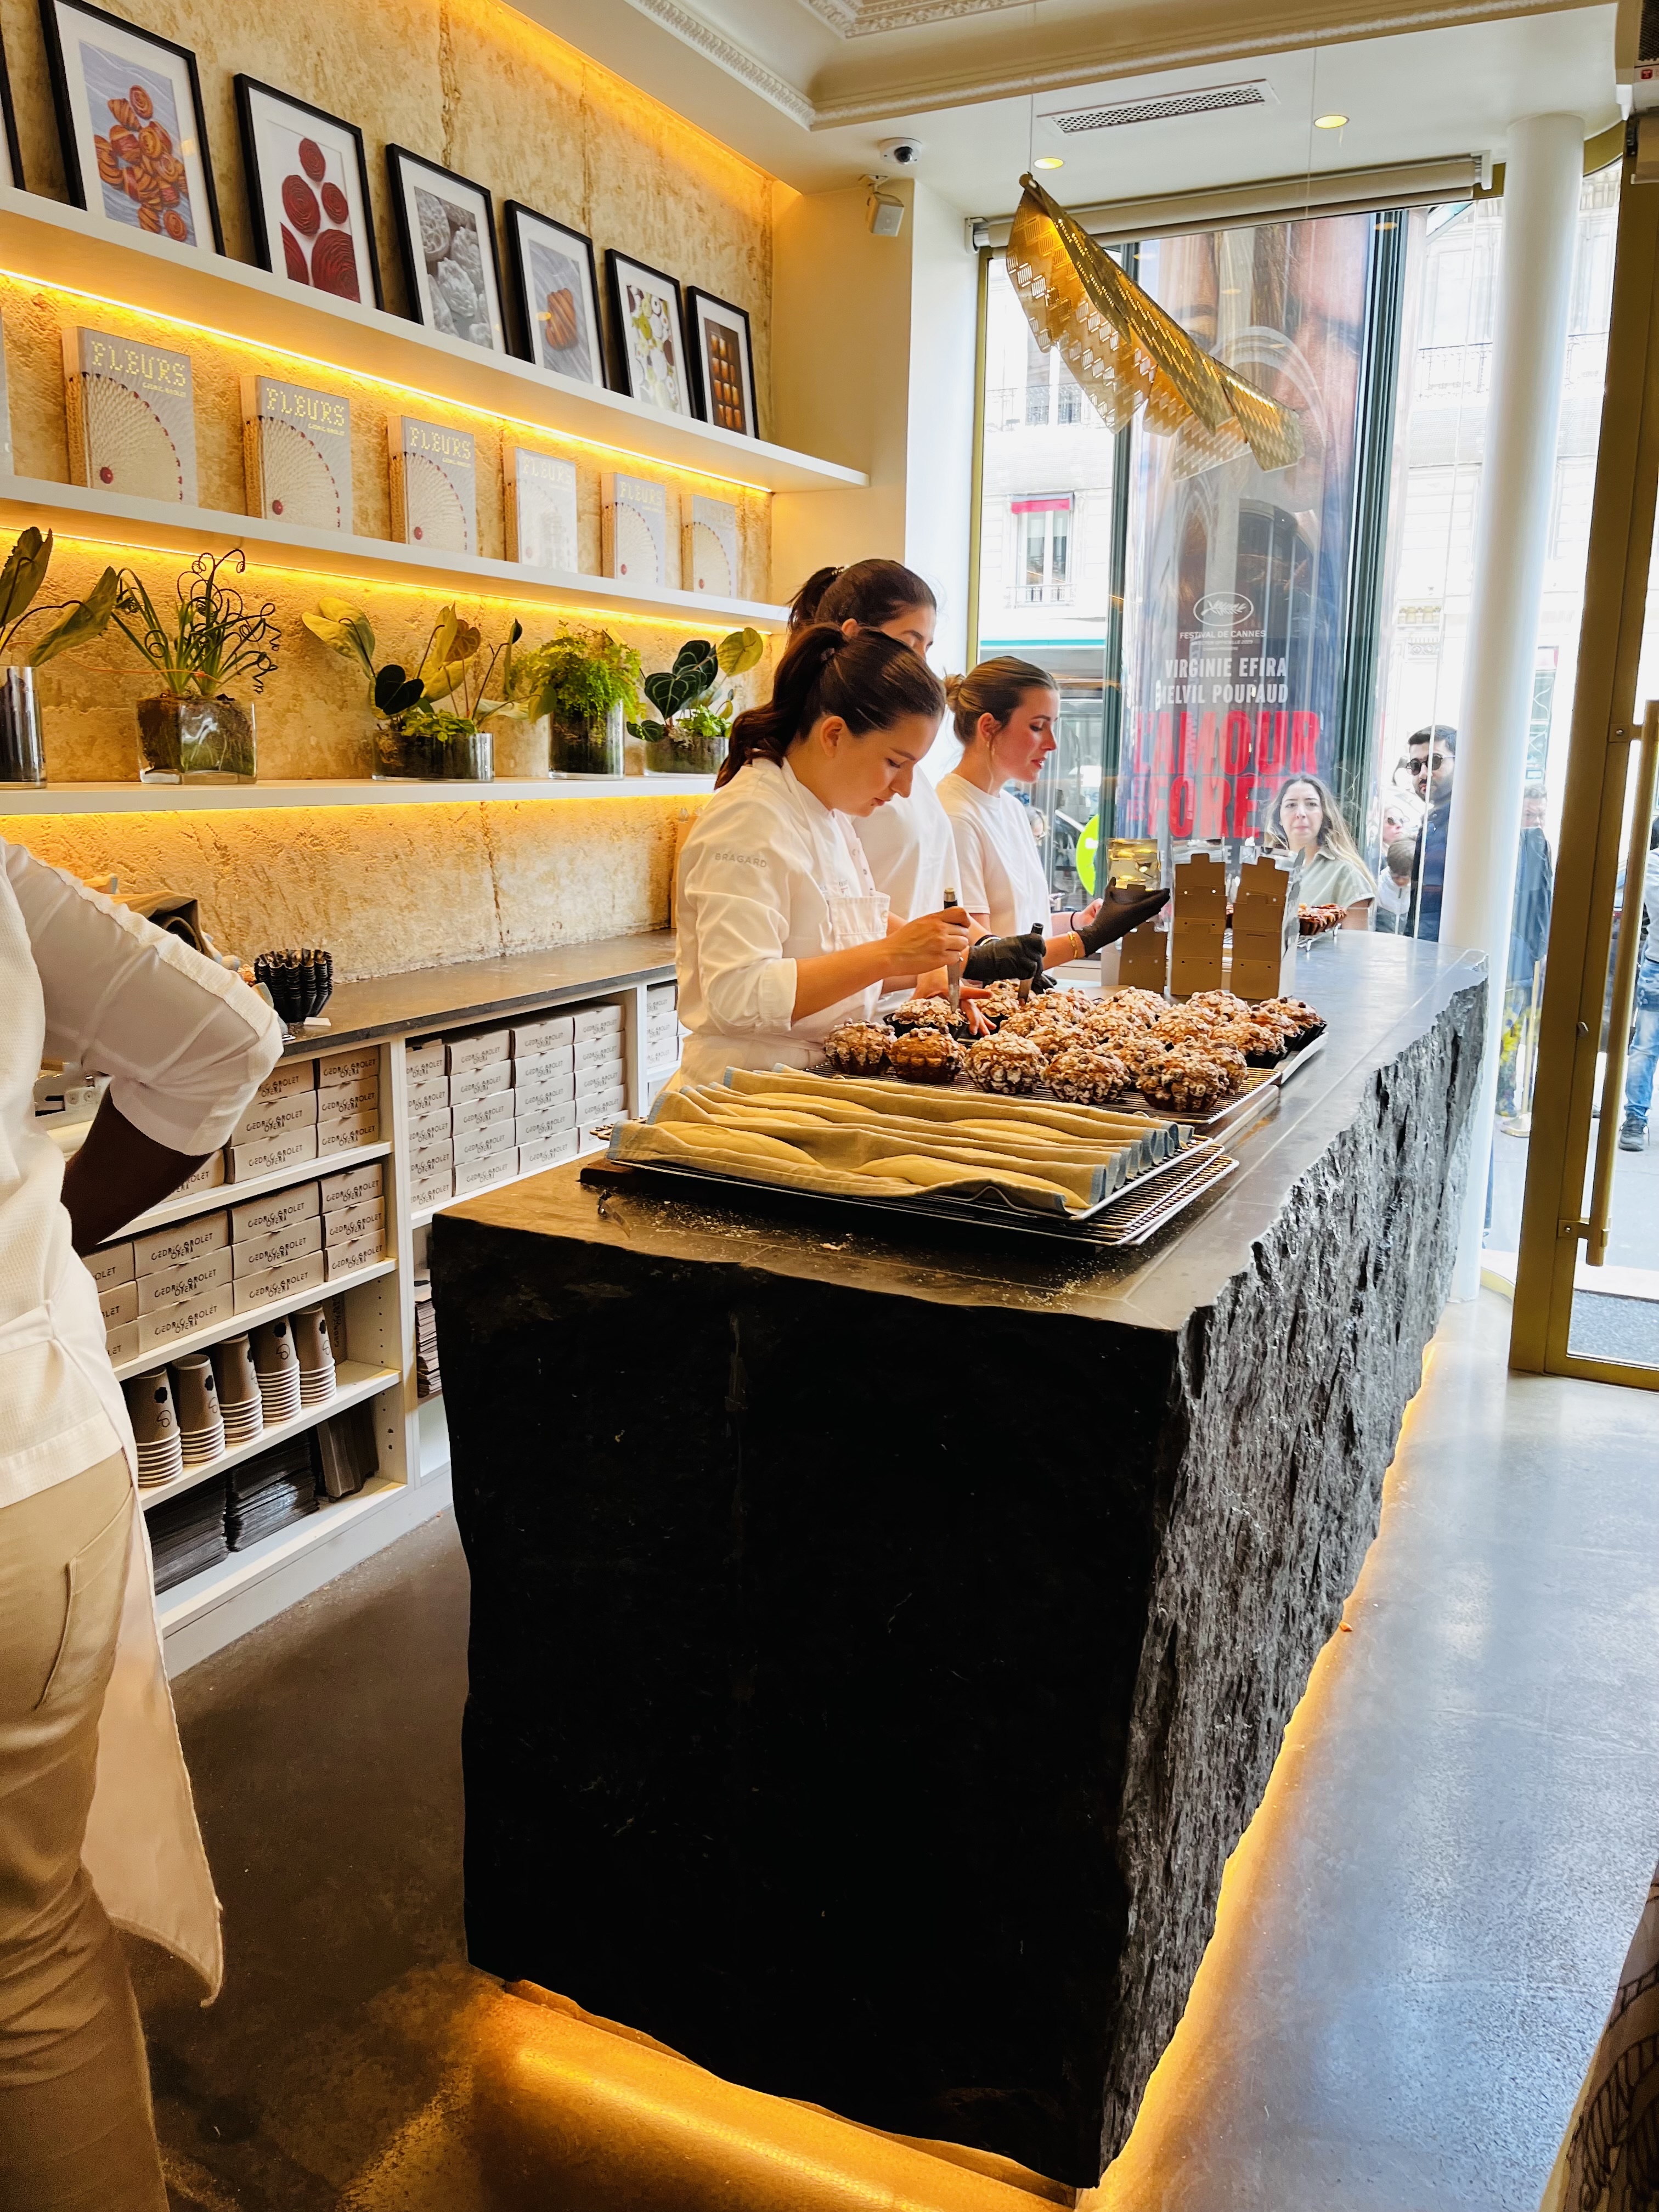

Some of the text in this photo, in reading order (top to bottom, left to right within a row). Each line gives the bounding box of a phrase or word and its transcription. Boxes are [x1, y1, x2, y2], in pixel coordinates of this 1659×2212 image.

[92, 341, 185, 386] FLEURS
[267, 387, 345, 426] FLEURS
[410, 427, 471, 459] FLEURS
[522, 456, 573, 485] FLEURS
[620, 481, 662, 506] FLEURS
[1180, 631, 1216, 639] FESTIVAL
[1231, 630, 1266, 638] CANNES
[1165, 658, 1287, 678] VIRGINIE EFIRA
[1212, 684, 1288, 704] POUPAUD
[1133, 710, 1320, 776] L'AMOUR
[715, 853, 766, 867] BRAGARD
[482, 1047, 500, 1056] GROLET
[324, 1059, 376, 1076] CEDRIC GROLET
[407, 1060, 442, 1074] DRIC GROLET
[273, 1076, 299, 1088] GROLET
[482, 1076, 501, 1085] GROLET
[322, 1093, 375, 1111] CEDRIC GROLET
[408, 1092, 445, 1107] DRIC GROLET
[484, 1106, 504, 1115] GROLET
[246, 1110, 302, 1131] CEDRIC GROLET
[322, 1126, 375, 1145] CEDRIC GROLET
[409, 1123, 448, 1140] EDRIC GROLET
[486, 1135, 505, 1145] GROLET
[249, 1145, 302, 1166] CEDRIC GROLET
[411, 1154, 449, 1171] DRIC GROLET
[188, 1171, 210, 1183] OLET
[488, 1164, 507, 1174] GROLET
[326, 1180, 379, 1201] CEDRIC GROLET
[411, 1184, 449, 1203] DRIC GROLET
[248, 1203, 304, 1227] CEDRIC GROLET
[330, 1213, 382, 1235] CEDRIC GROLET
[151, 1233, 213, 1261] CEDRIC GROLET
[249, 1238, 306, 1263] CEDRIC GROLET
[332, 1245, 383, 1269] CEDRIC GROLET
[94, 1267, 116, 1280] OLET
[155, 1269, 217, 1297] CEDRIC GROLET
[250, 1272, 308, 1298] CEDRIC GROLET
[102, 1306, 120, 1318] LET
[155, 1306, 217, 1335] CEDRIC GROLET
[108, 1345, 121, 1356] LET
